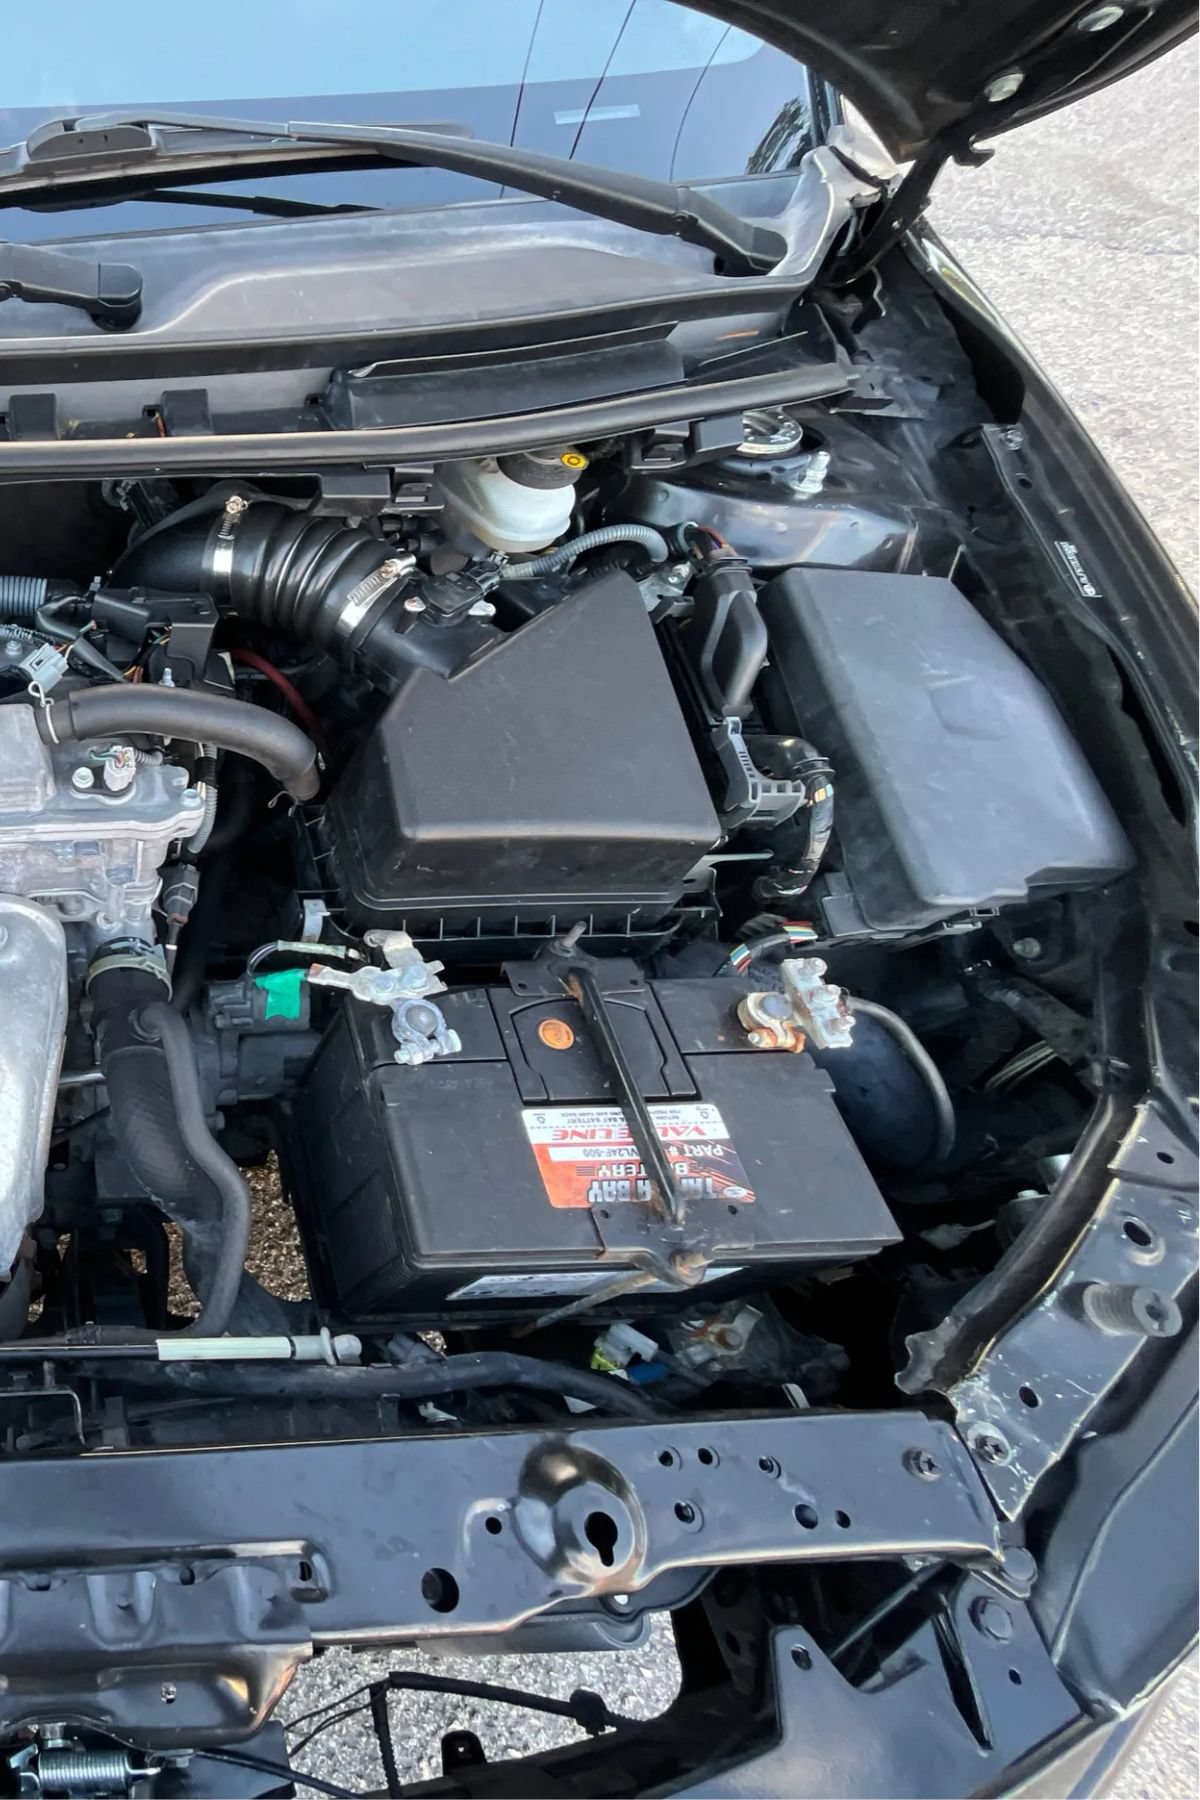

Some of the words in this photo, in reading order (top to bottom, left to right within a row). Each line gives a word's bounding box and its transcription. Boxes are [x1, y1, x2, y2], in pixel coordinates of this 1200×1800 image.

[551, 1128, 612, 1140] LINE
[618, 1126, 707, 1139] VALE
[683, 1144, 724, 1157] PART
[597, 1162, 689, 1177] BTERY
[588, 1180, 631, 1202] BAY
